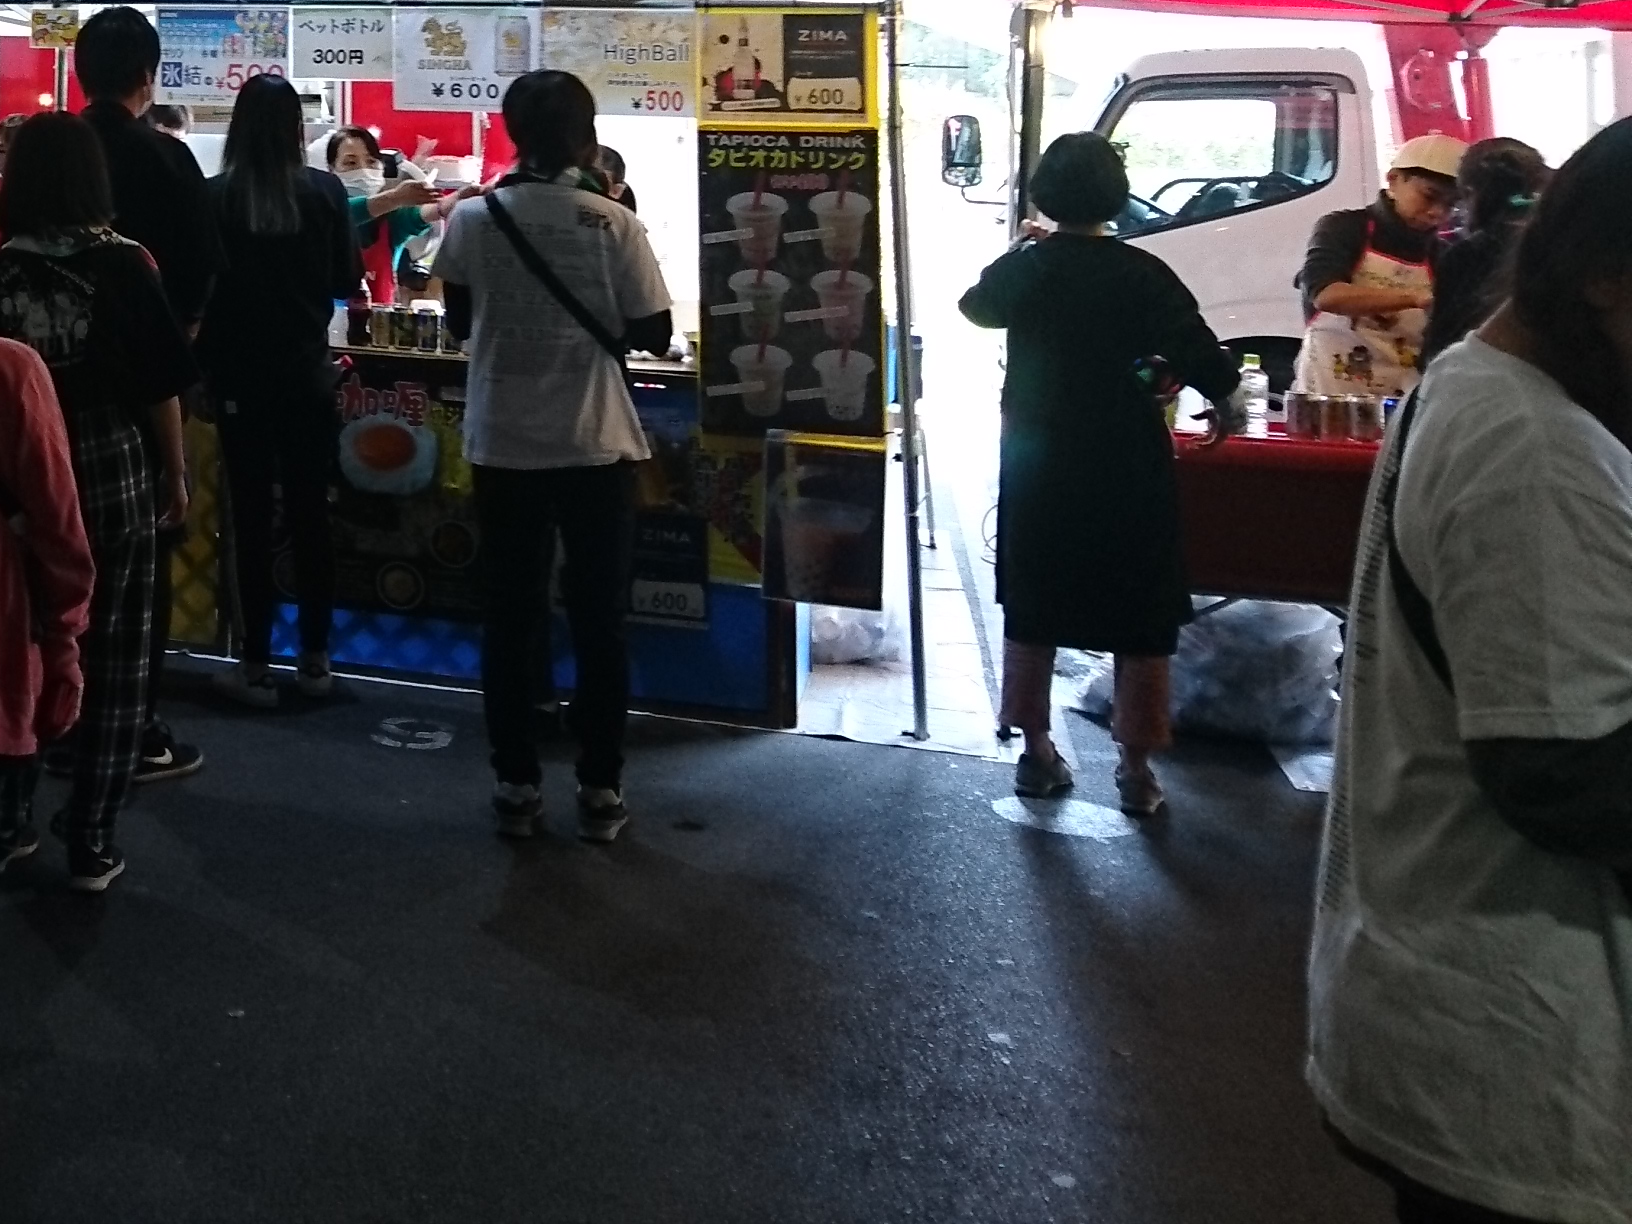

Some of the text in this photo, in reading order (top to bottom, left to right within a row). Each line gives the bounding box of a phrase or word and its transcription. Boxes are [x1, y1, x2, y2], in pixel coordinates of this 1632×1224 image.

[298, 17, 386, 36] ペットボトル
[798, 29, 848, 42] ZIMA
[312, 48, 365, 65] 300円
[603, 43, 690, 64] HighBall
[417, 58, 472, 71] SINGHA
[161, 62, 203, 87] 氷結
[431, 82, 500, 99] ¥600
[794, 88, 844, 105] ¥600
[631, 90, 684, 112] ¥500
[706, 134, 866, 149] TAPIOCA DRINK
[707, 148, 866, 170] タピオカドリンク
[641, 528, 691, 544] ZIMA
